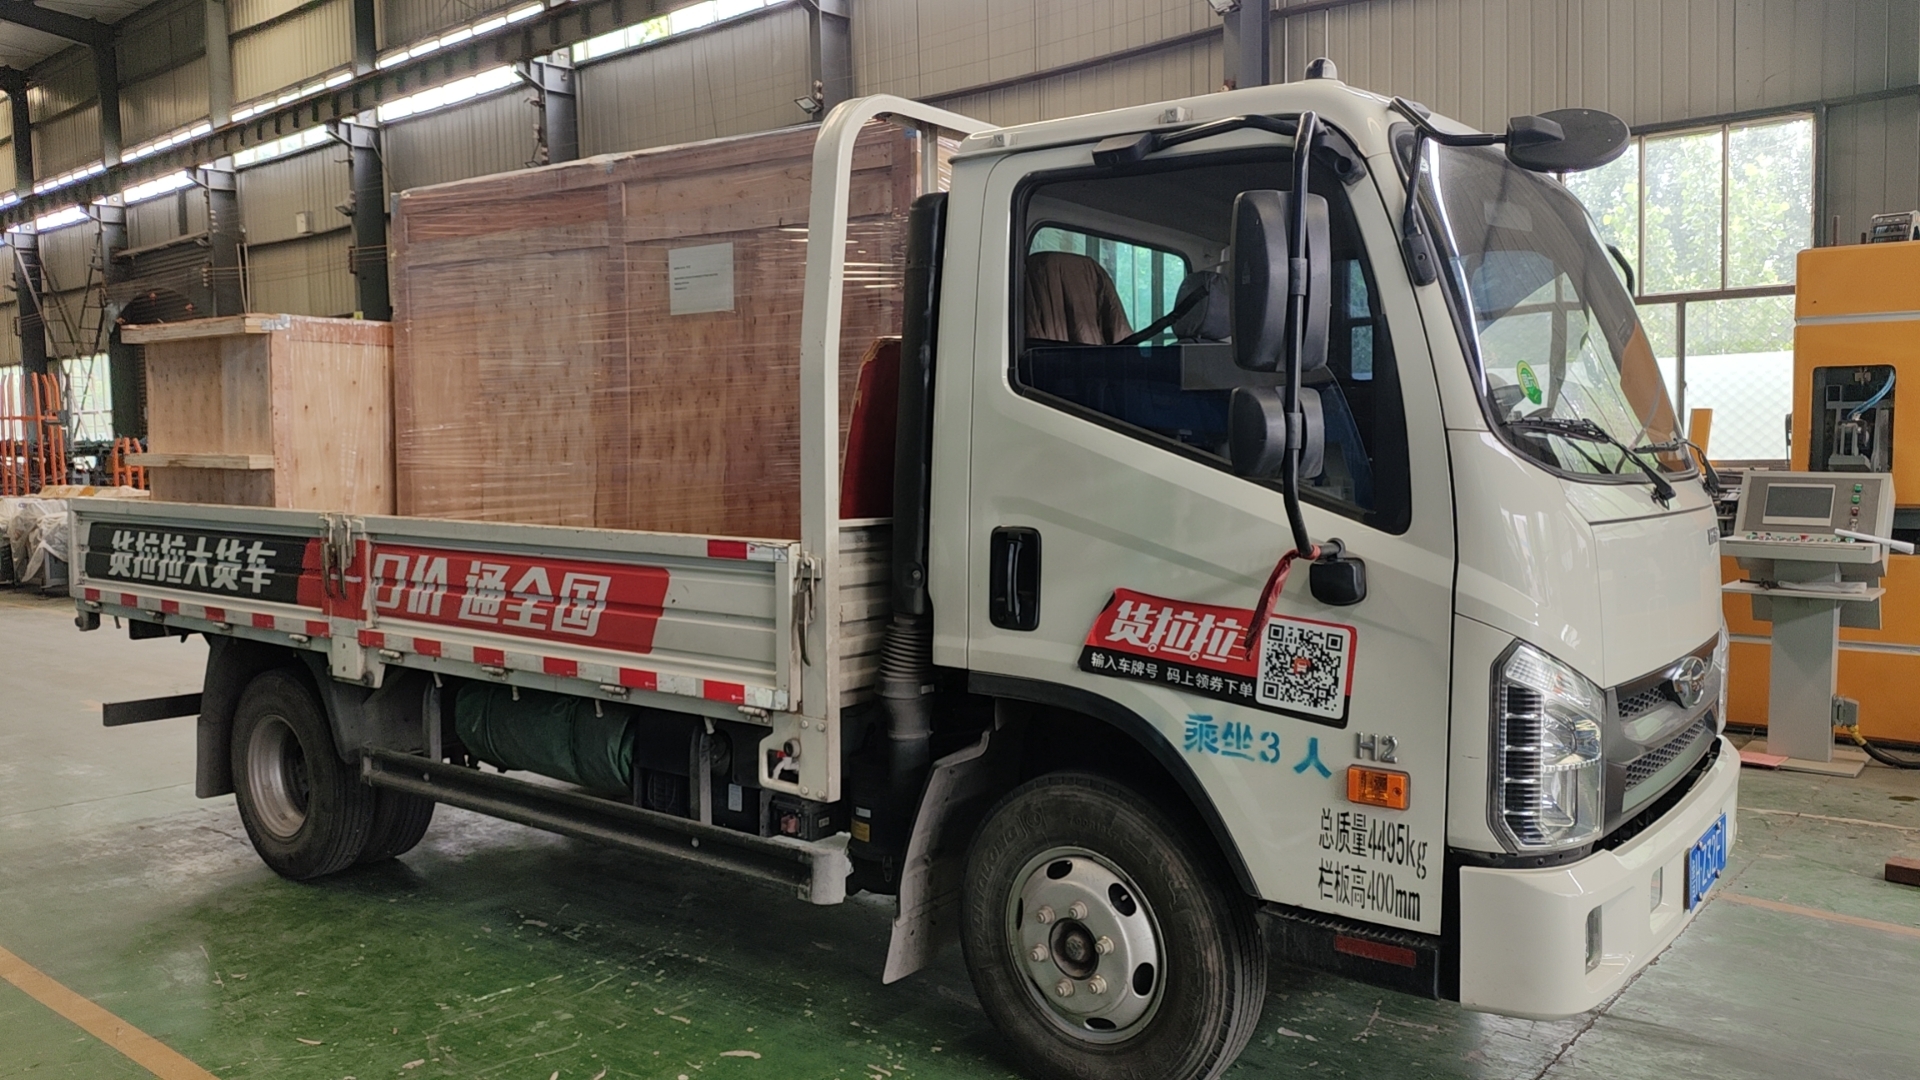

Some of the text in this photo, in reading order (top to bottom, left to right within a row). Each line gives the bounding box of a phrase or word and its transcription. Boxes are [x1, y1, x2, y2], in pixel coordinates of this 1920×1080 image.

[108, 530, 277, 594] 货拉拉大货车
[458, 561, 612, 638] 通全国
[1105, 600, 1243, 663] 货拉拉
[1091, 652, 1253, 698] 输入车牌号 码上领券下单
[1355, 731, 1400, 763] H2
[1318, 808, 1428, 880] 总质量4495kg
[1318, 857, 1421, 922] 栏板高400mm
